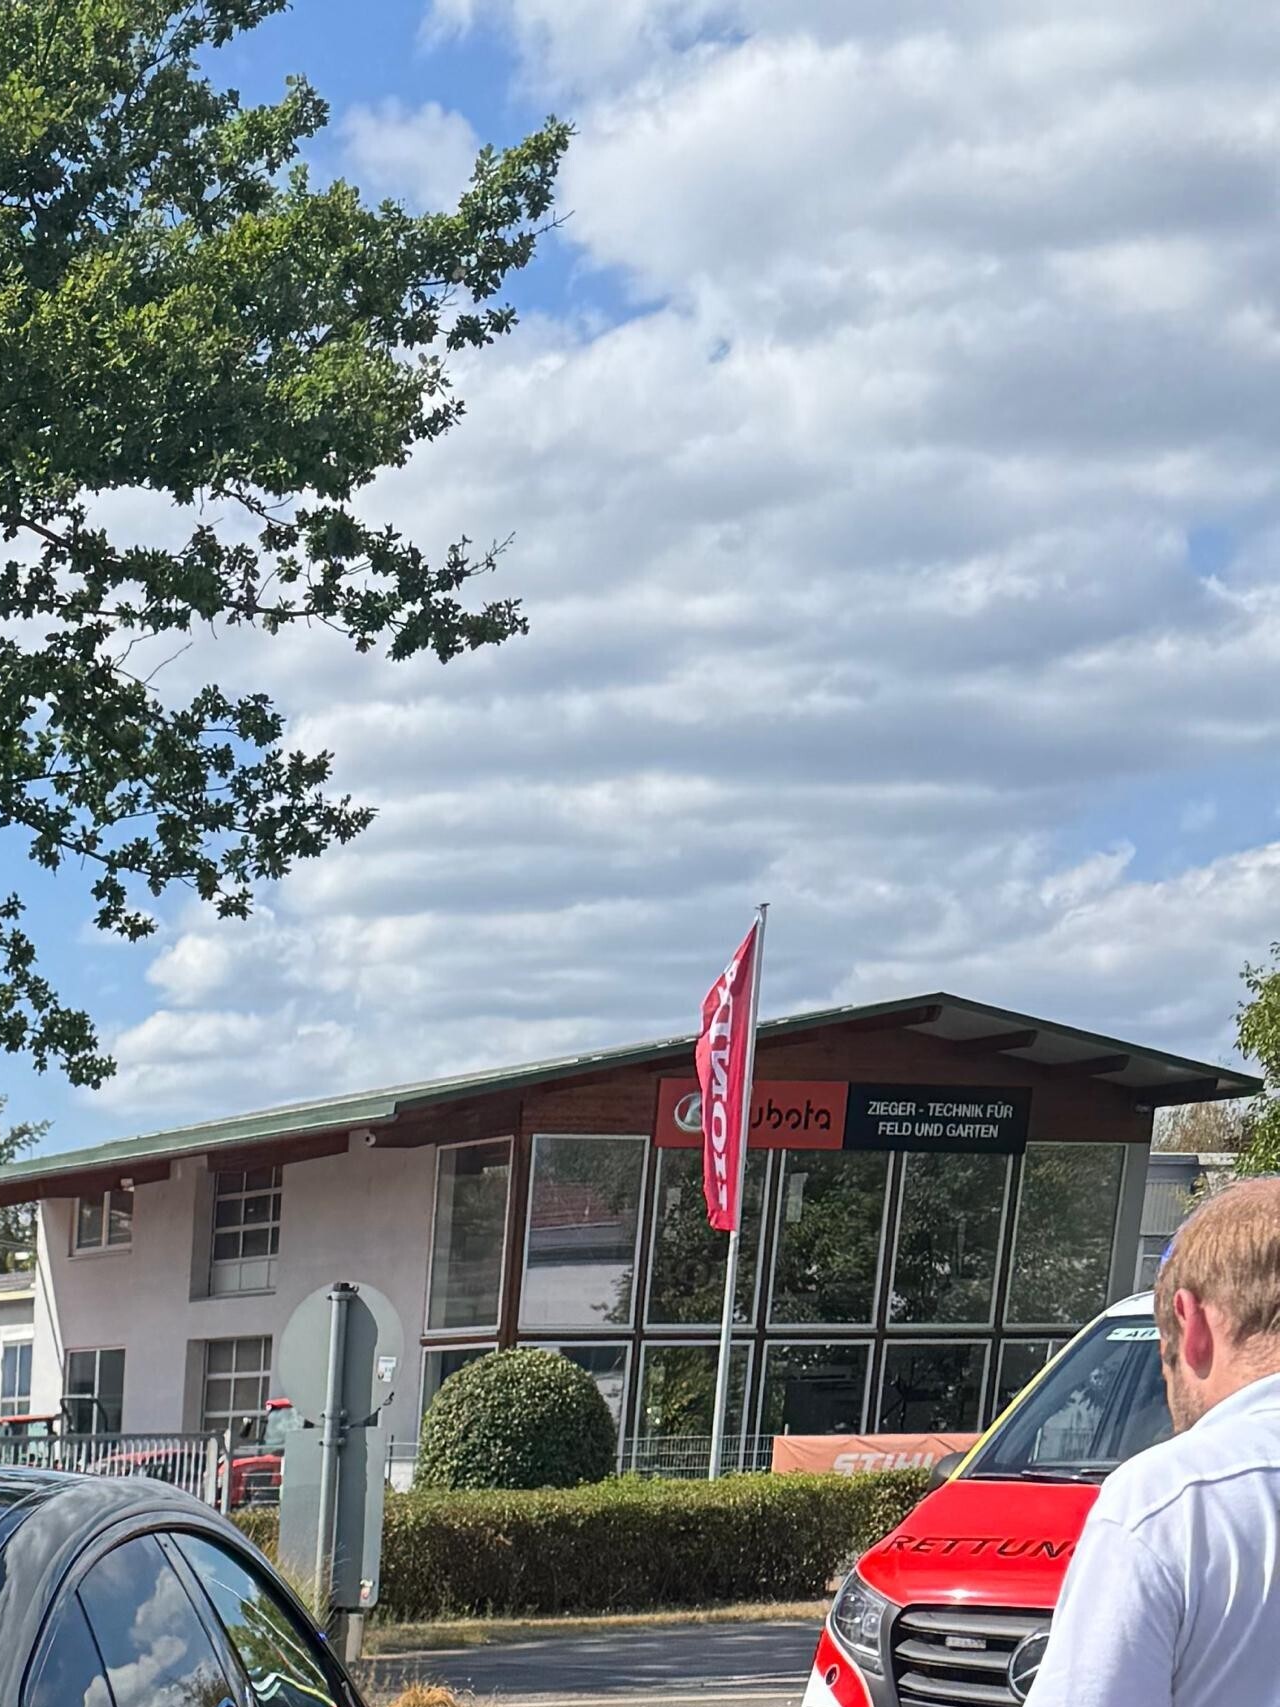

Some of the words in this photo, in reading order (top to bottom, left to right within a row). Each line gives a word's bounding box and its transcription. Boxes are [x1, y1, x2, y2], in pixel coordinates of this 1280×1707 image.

[867, 1100, 917, 1118] ZIEGER
[927, 1102, 984, 1119] TECHNIK
[986, 1100, 1014, 1120] FÜR
[877, 1121, 913, 1137] FELD
[915, 1122, 943, 1138] UND
[945, 1122, 999, 1139] GARTEN
[881, 1534, 1077, 1559] RETTUN
